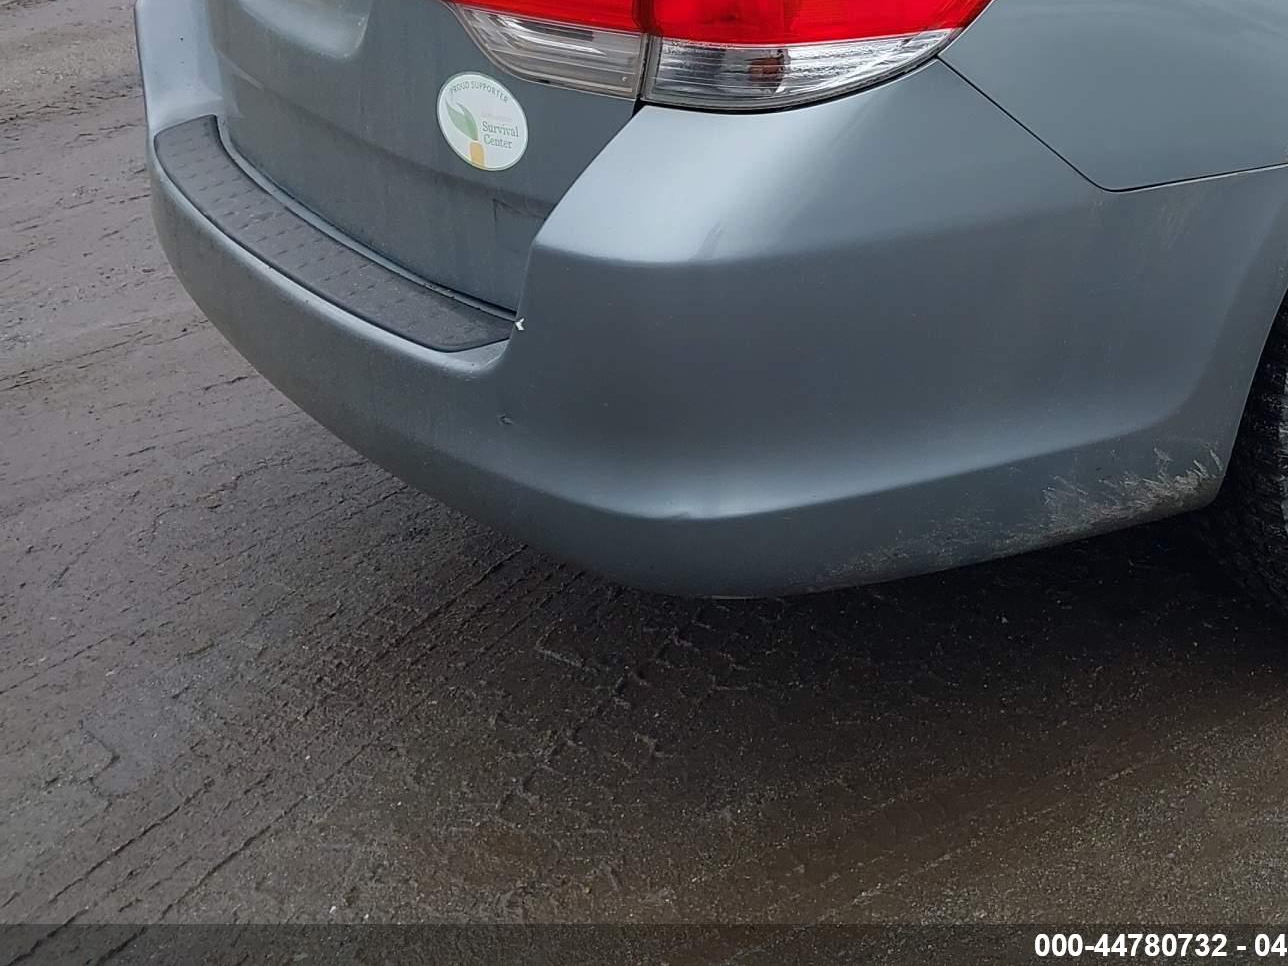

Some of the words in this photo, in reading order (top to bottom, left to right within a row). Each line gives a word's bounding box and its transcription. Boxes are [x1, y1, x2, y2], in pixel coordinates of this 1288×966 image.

[450, 81, 470, 94] PROUD
[471, 81, 508, 102] SUPPORTER
[482, 121, 519, 137] Survival
[484, 134, 513, 149] Center
